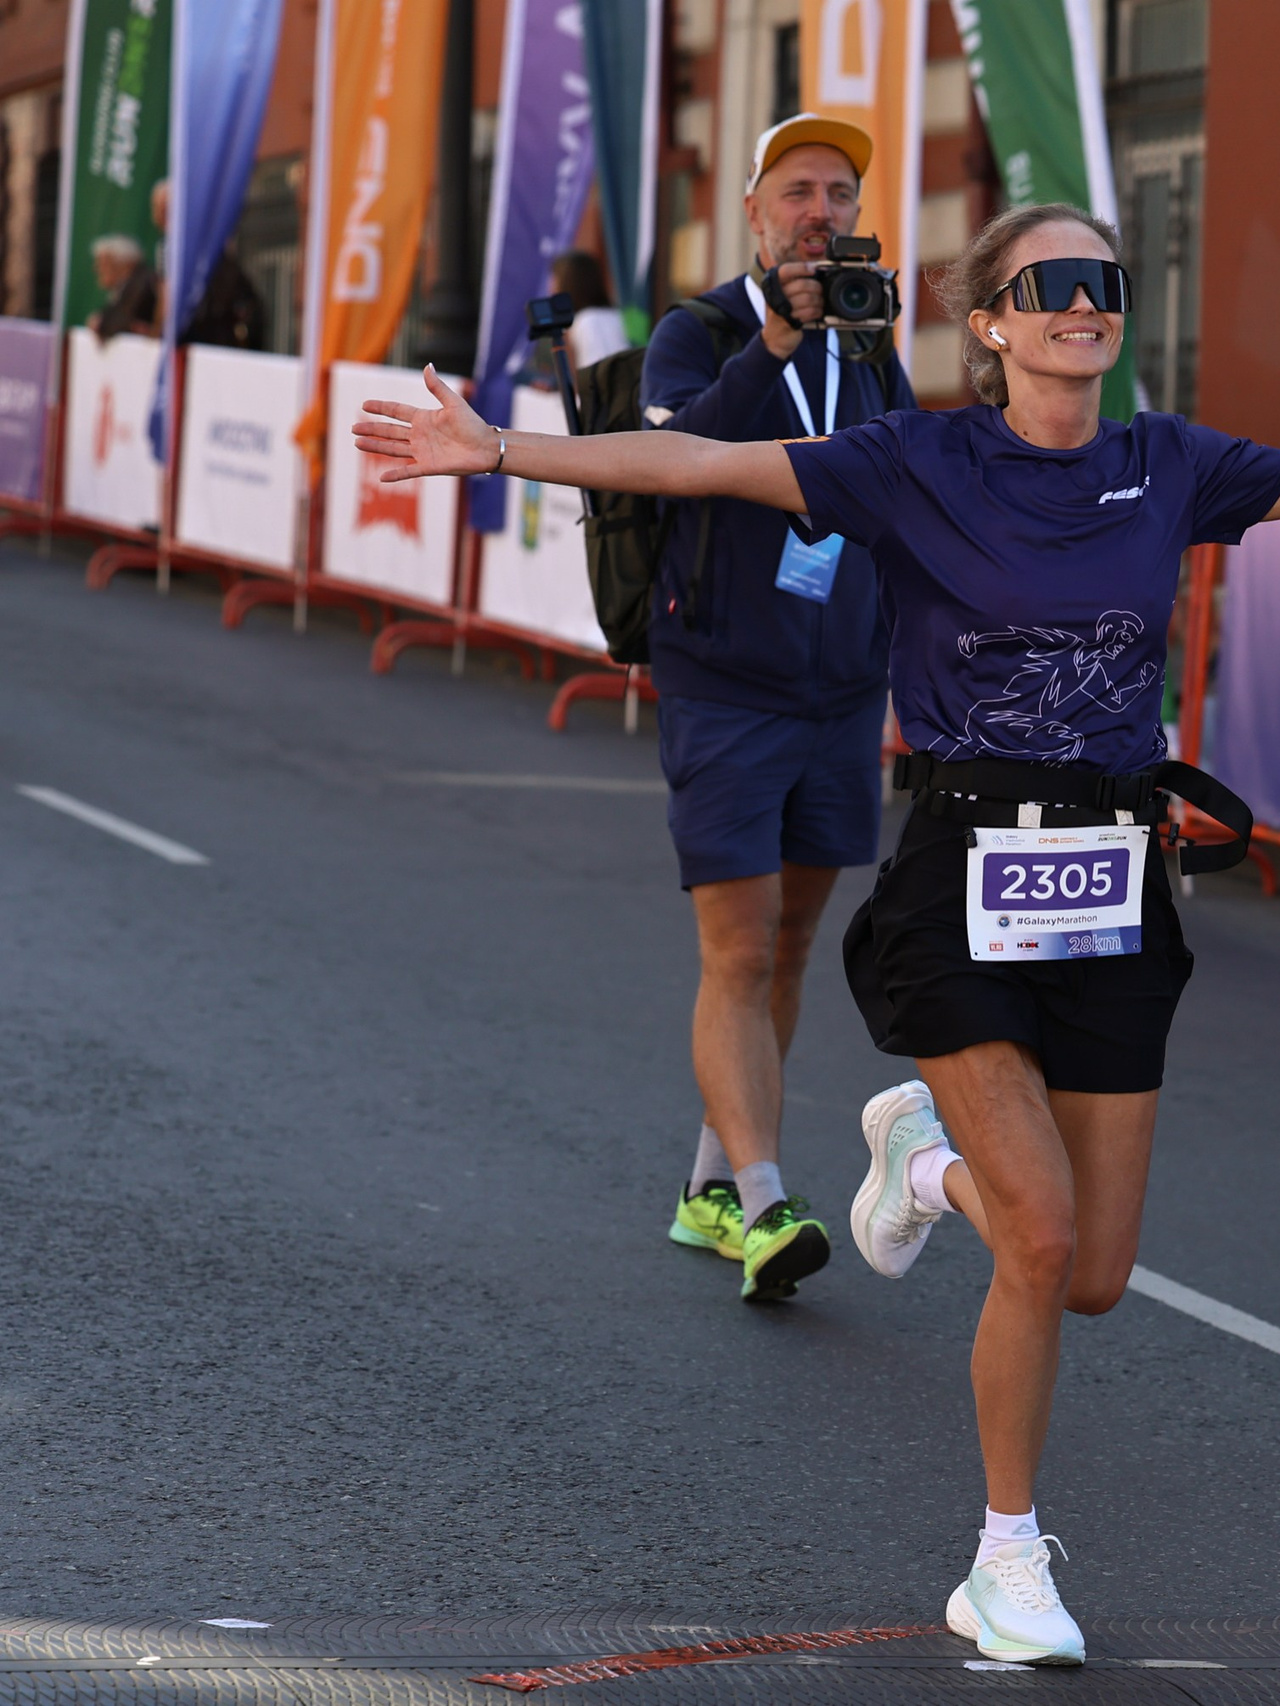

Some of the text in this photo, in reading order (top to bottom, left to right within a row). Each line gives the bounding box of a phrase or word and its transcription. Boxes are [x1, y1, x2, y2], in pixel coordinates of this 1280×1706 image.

[1000, 860, 1112, 900] 2305
[1017, 915, 1098, 926] #GalaxyMarathon
[1068, 934, 1121, 954] 28km
